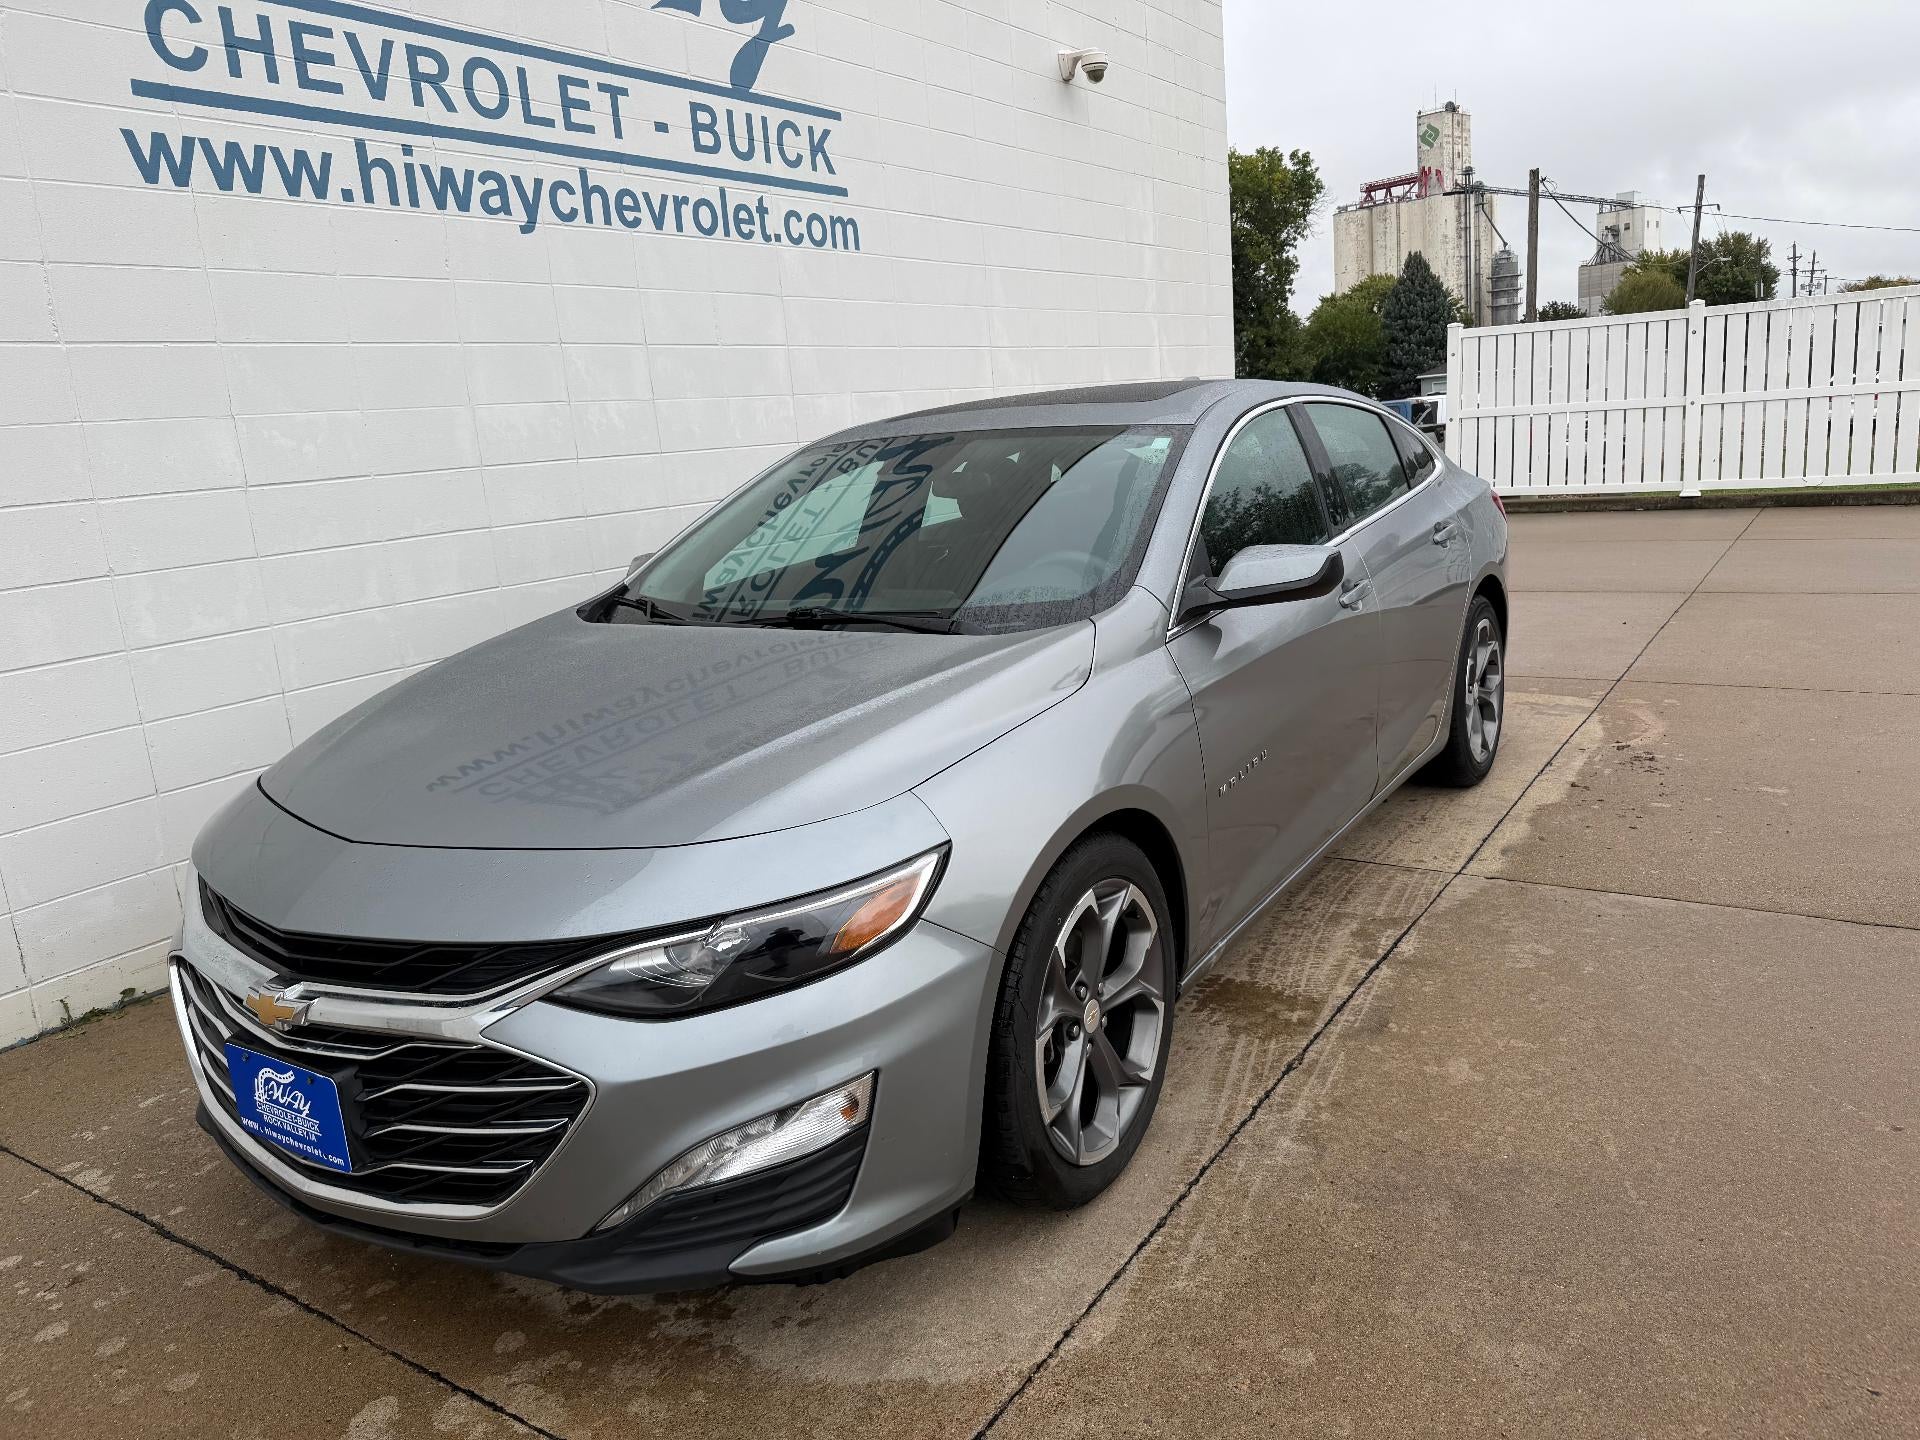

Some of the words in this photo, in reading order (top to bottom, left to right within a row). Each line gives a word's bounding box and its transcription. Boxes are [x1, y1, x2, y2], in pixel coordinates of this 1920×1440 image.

[143, 0, 630, 140] CHEVROLET
[688, 100, 837, 175] BUICK
[119, 127, 861, 251] www.hiwaychevrolet.com
[1218, 748, 1268, 798] MALIBU
[263, 1113, 283, 1129] ROCK
